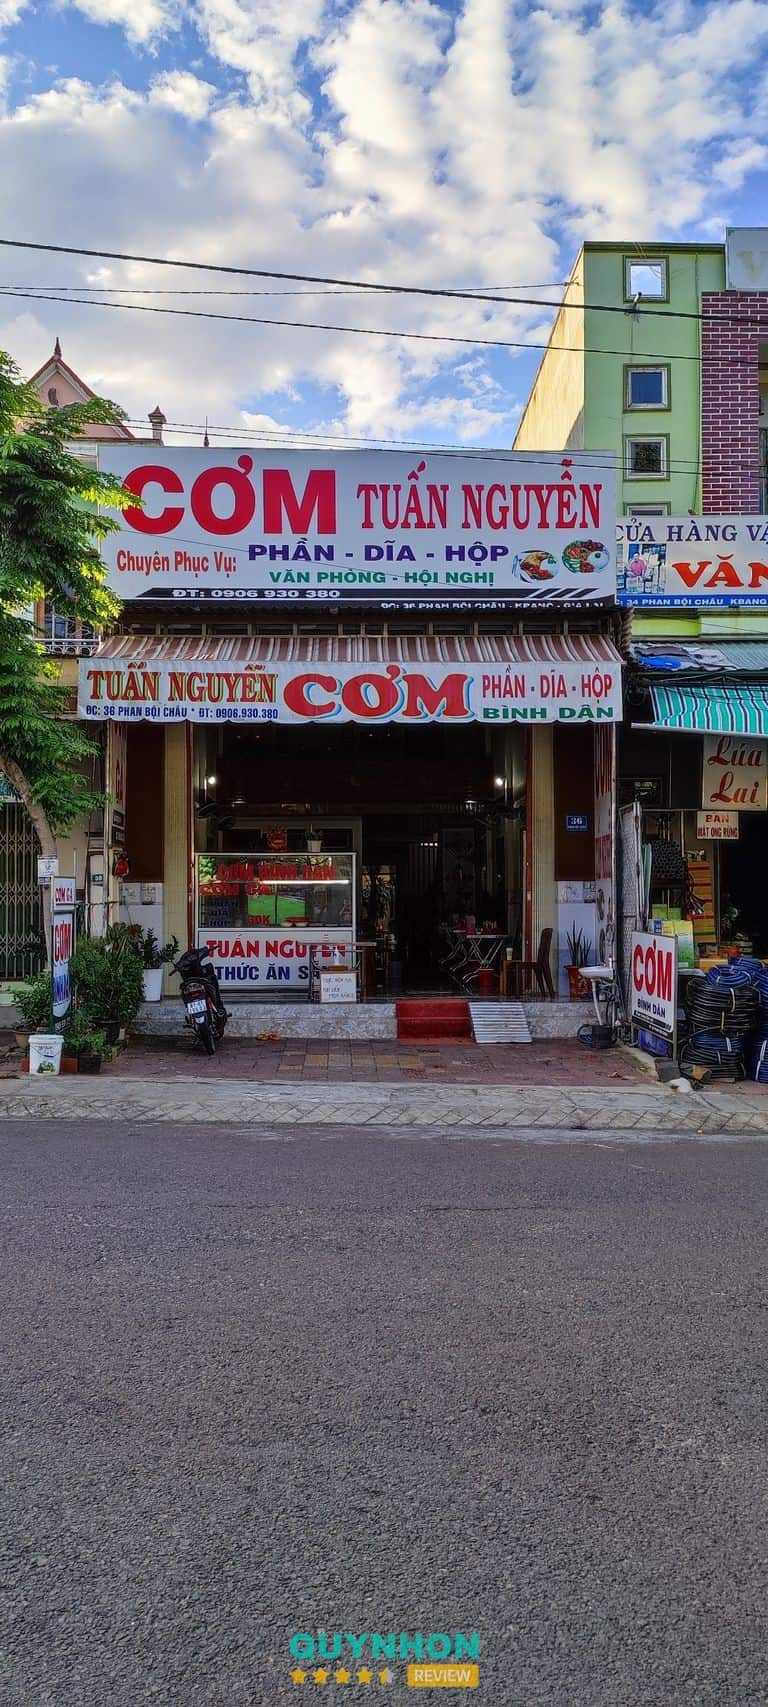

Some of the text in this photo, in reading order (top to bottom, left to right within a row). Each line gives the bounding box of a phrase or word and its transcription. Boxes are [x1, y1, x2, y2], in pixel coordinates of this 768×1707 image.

[121, 455, 336, 535] CƠM
[357, 459, 602, 530] TUẤN NGUYỄN
[615, 518, 655, 542] CỬA
[667, 520, 738, 542] HÀNG
[116, 550, 237, 578] Chuyên Phục Vụ:
[248, 538, 509, 566] PHẦN DĨA HỘP
[269, 568, 494, 587] VĂN PHÒNG HỘI NGHỊ
[172, 589, 341, 598] ĐT: 0906 930 380
[694, 597, 723, 605] CHÂU
[87, 662, 612, 718] TUẤN NGUYỄN CƠM PHẦN DĨA HỘP
[86, 705, 278, 720] ĐC: 36 PHAN BỘI CHÂU ĐT: 0906.930.380
[482, 703, 614, 719] BÌNH DÂN
[206, 934, 259, 959] TUẤN
[215, 962, 260, 980] THỨC
[266, 963, 290, 980] ĂN
[633, 939, 672, 1002] CƠM
